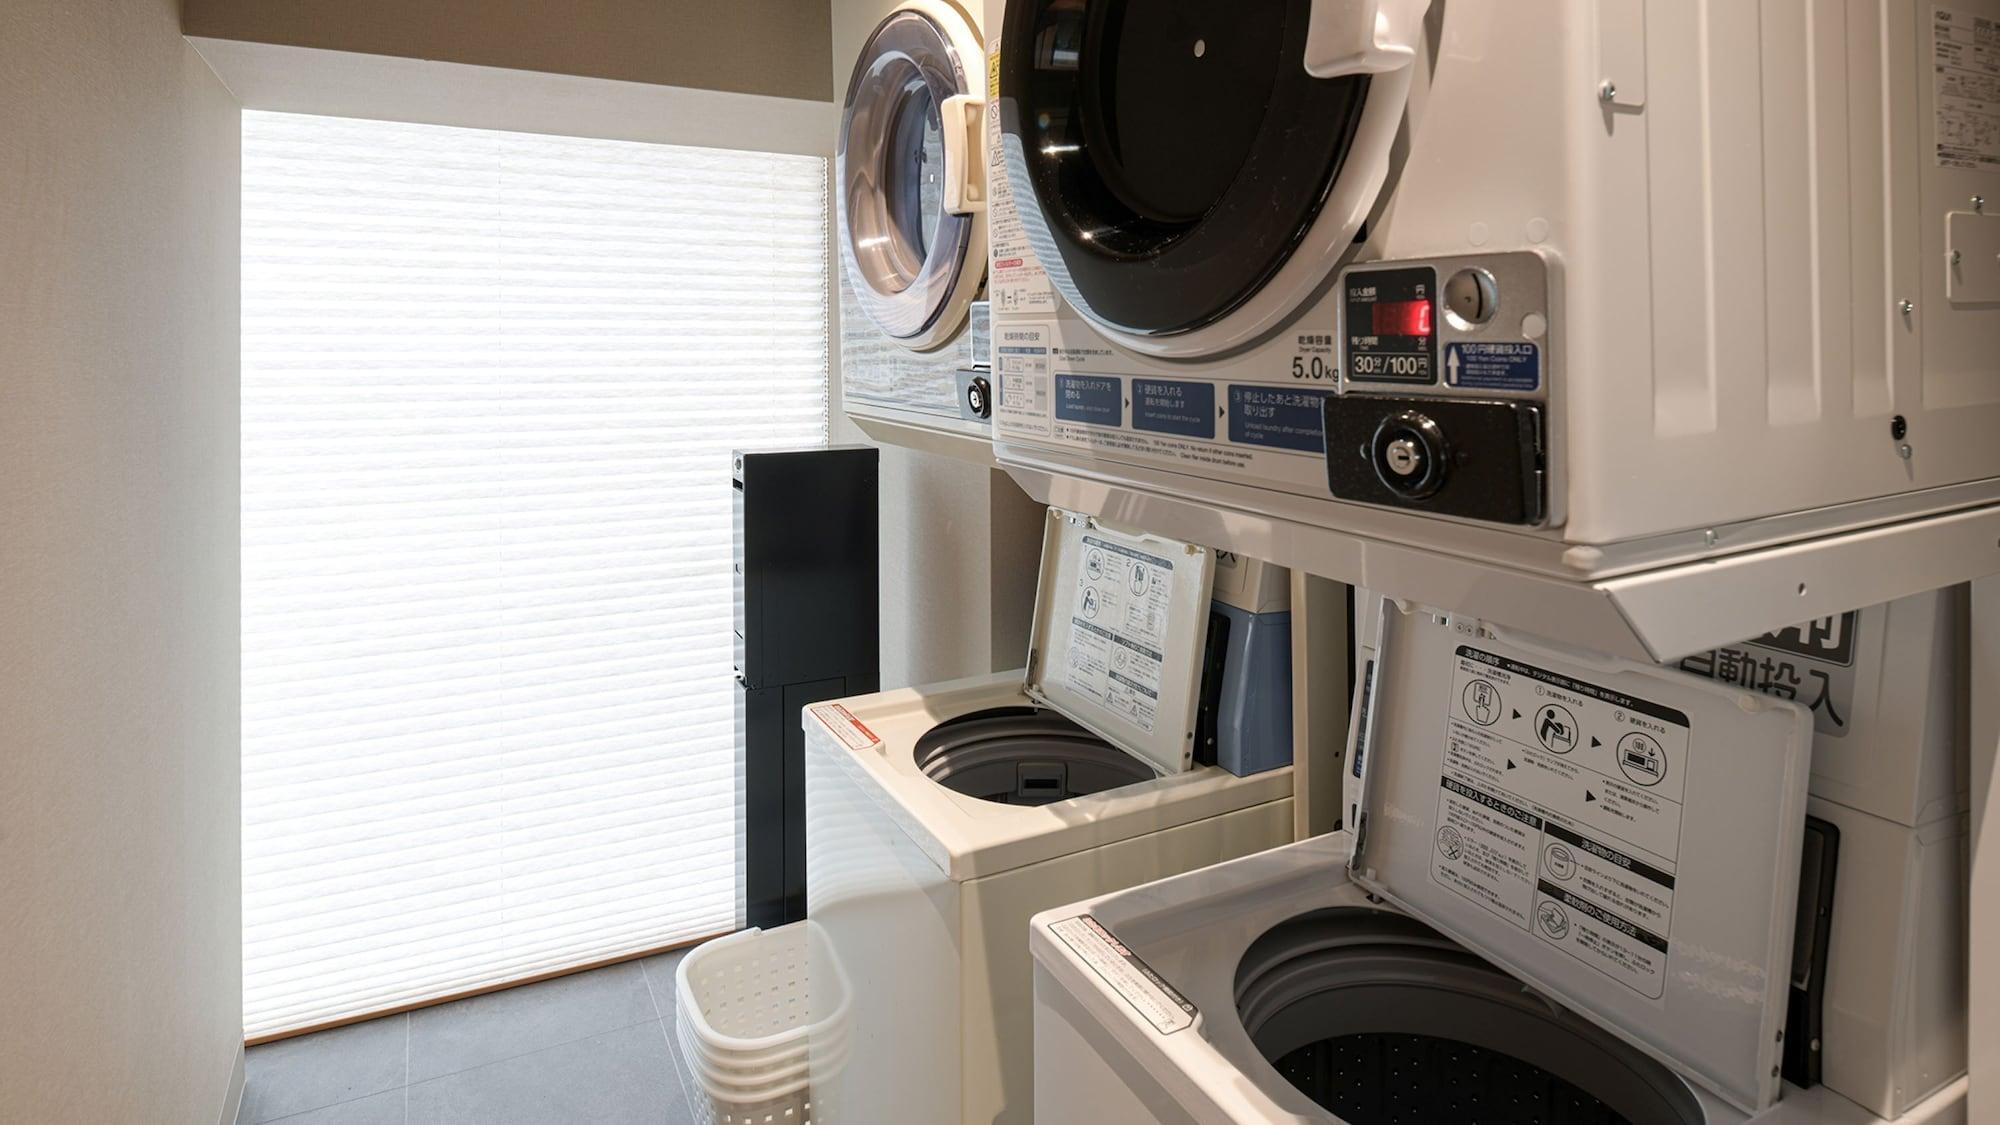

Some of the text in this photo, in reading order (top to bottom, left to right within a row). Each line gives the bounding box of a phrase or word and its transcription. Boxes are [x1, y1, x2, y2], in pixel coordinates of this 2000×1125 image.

[1298, 335, 1332, 345] 乾燥容量
[1461, 344, 1533, 355] 100円硬貨投入口
[1244, 404, 1276, 418] 取り出す
[1445, 778, 1537, 827] 硬貨を投入するときのご注意
[1580, 838, 1631, 869] 洗濯物の目安
